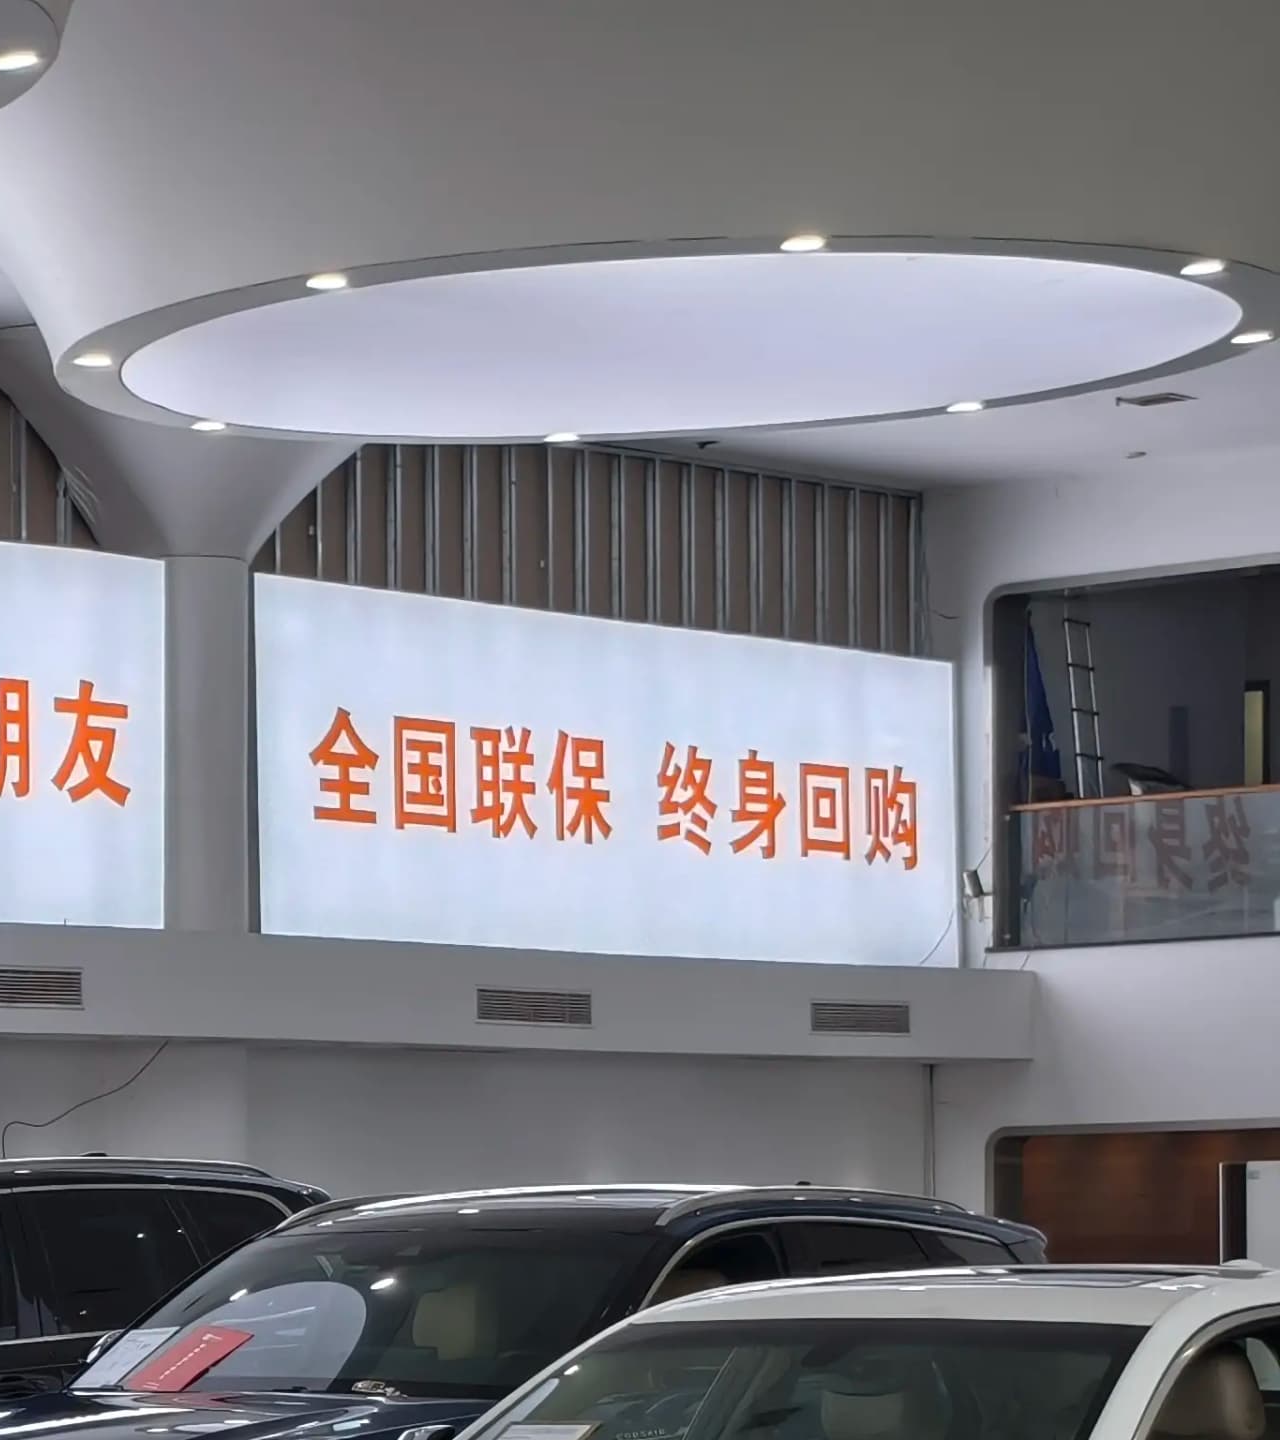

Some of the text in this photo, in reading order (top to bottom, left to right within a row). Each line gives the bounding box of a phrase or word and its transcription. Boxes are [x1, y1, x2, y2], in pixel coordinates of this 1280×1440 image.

[309, 706, 919, 871] 全国联保 终身回购
